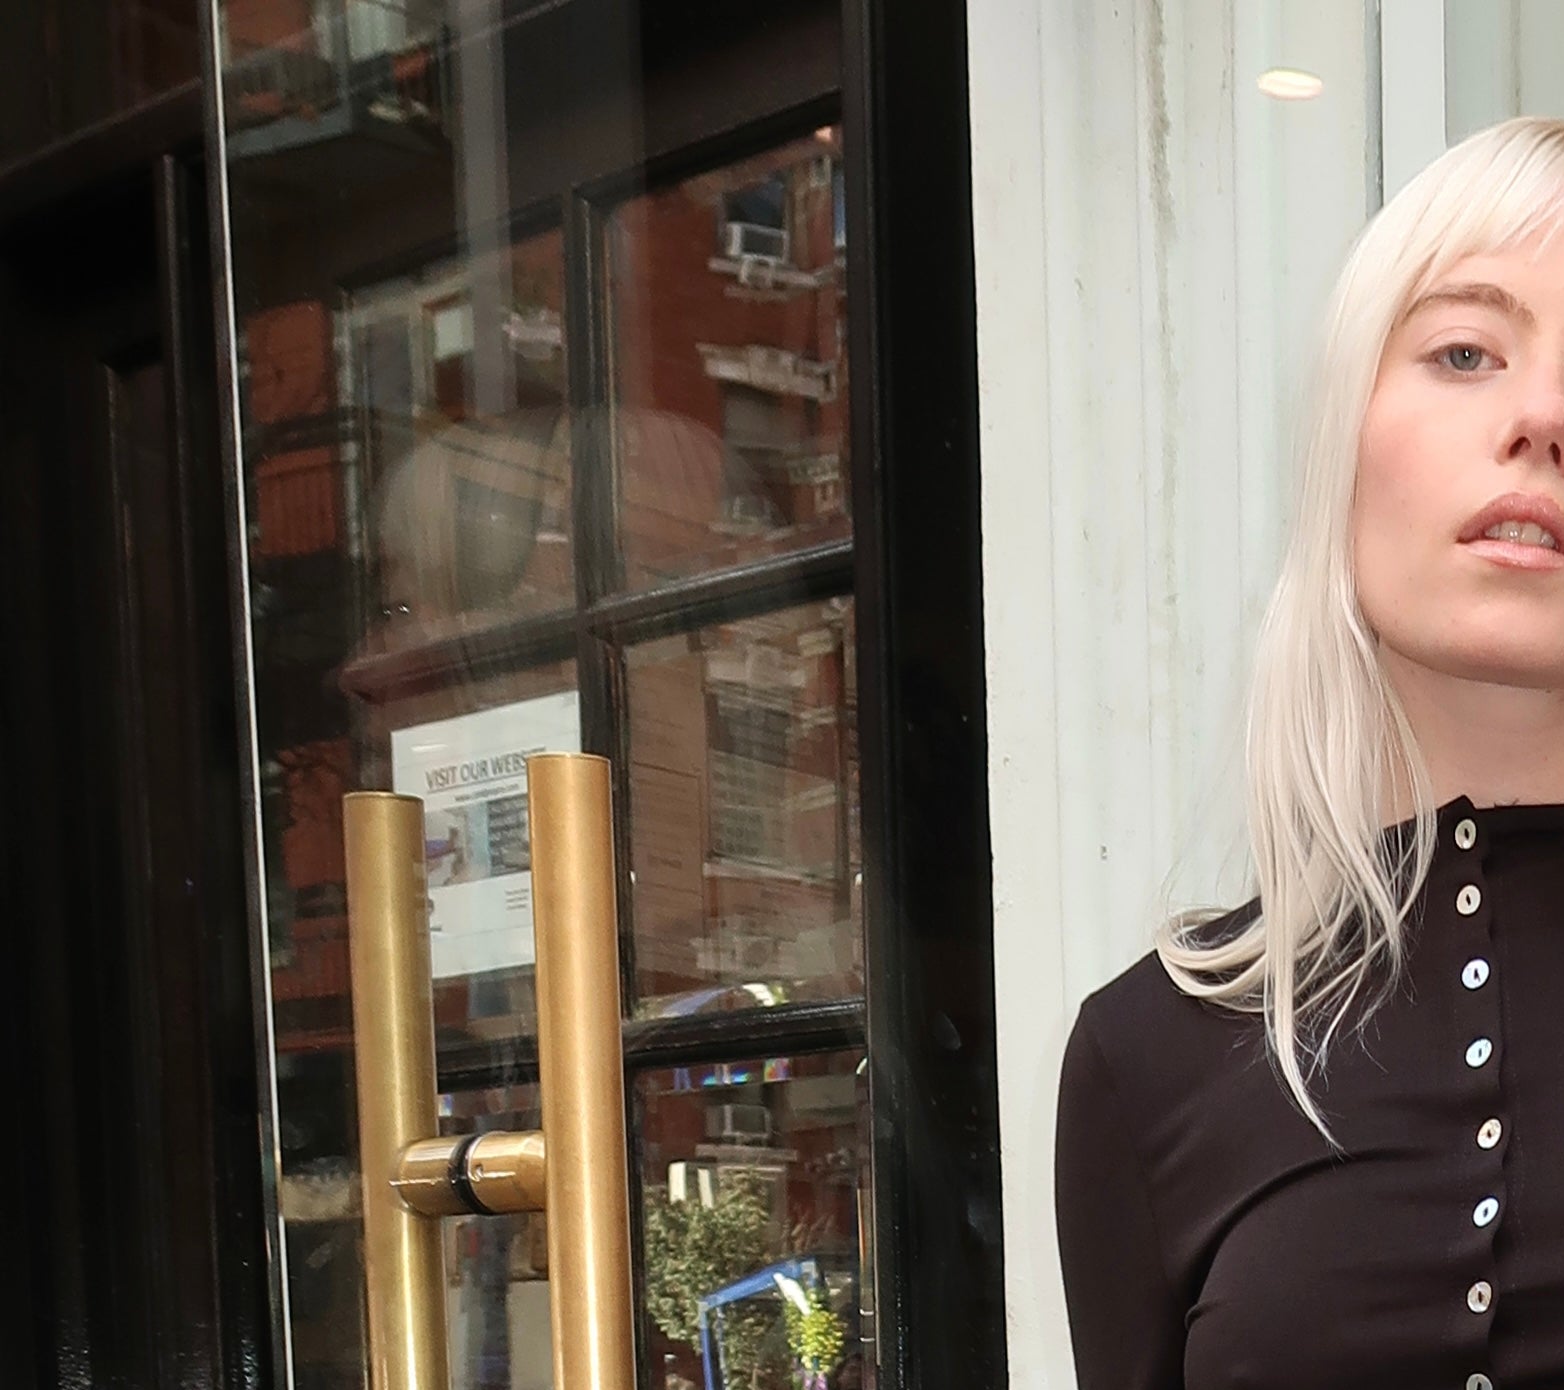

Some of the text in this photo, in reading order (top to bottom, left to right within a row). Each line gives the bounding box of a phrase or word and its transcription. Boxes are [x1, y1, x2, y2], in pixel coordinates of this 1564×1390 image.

[425, 747, 544, 790] VISIT OUR WEBS
